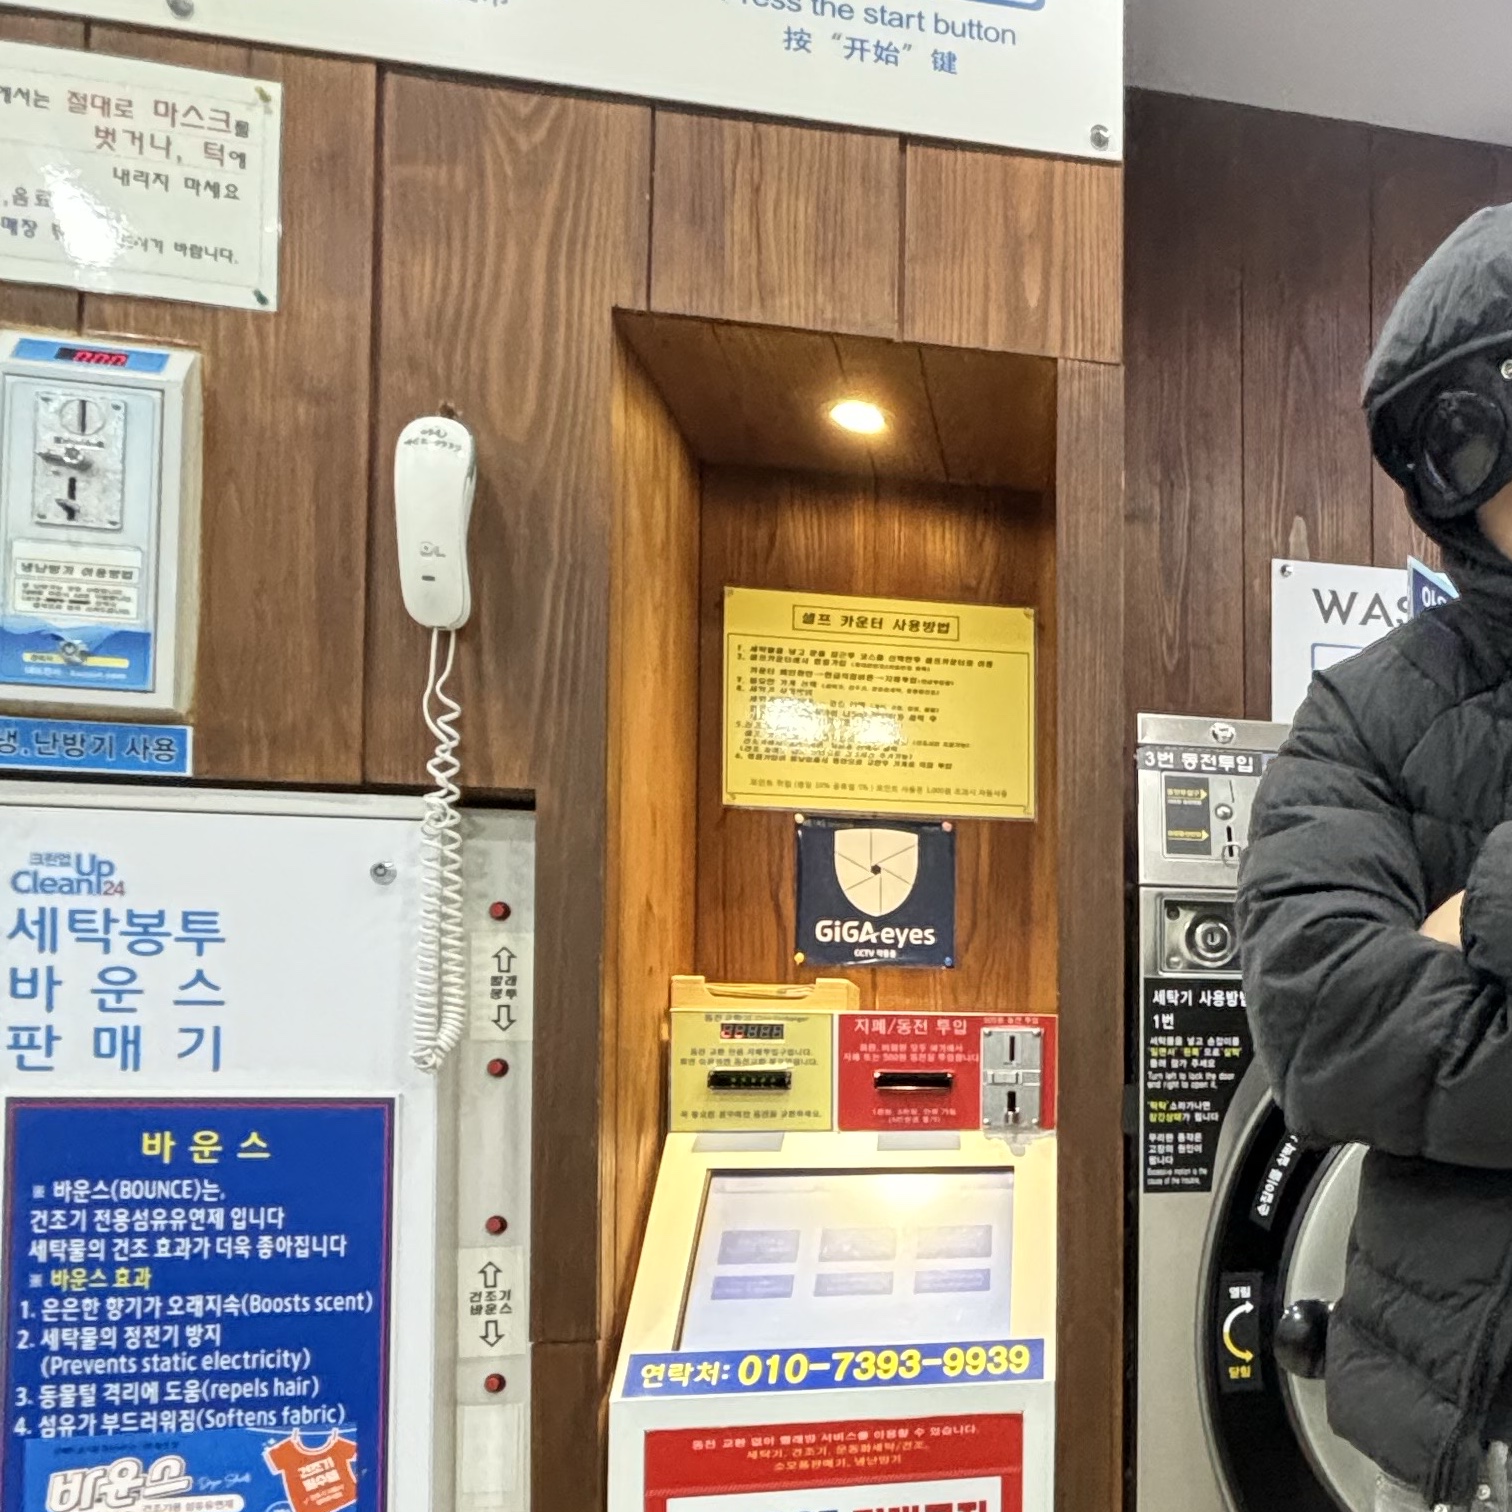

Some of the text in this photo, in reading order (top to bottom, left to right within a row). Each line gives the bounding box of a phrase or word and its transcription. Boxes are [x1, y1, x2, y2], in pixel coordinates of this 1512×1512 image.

[812, 0, 1017, 45] the start button
[66, 90, 134, 120] 절대로
[153, 99, 249, 138] 마스크를
[94, 125, 246, 169] 벗거나, 턱에
[113, 166, 240, 200] 내리지 마세요
[174, 242, 238, 264] 바랍니다.
[802, 611, 951, 635] 셀프 카운터 사용방법
[126, 734, 177, 763] 사용
[1145, 751, 1254, 774] 3번 동전투입
[103, 880, 126, 897] 24
[7, 906, 226, 957] 세탁봉투
[1152, 989, 1193, 1006] 세탁기
[854, 1018, 928, 1035] 지폐/동전
[936, 1018, 967, 1036] 투입
[1153, 1013, 1175, 1030] 1번
[30, 1206, 285, 1233] 건조기 전용섬유유연제 입니다
[28, 1234, 348, 1263] 세탁물의 건조 효과가 더욱 좋아집니다
[50, 1266, 152, 1291] 바운스 효과
[41, 1298, 101, 1322] 은은한
[106, 1296, 163, 1321] 향기가
[314, 1290, 374, 1314] scent)
[470, 1303, 513, 1316] 바운스
[40, 1323, 222, 1350] 세탁물의 정전기 방지
[41, 1347, 312, 1378] (Prevents static electricity)
[640, 1343, 1031, 1389] 연락처: 010-7393-9939
[38, 1381, 97, 1409] 동물털
[103, 1380, 160, 1406] 격리에
[273, 1375, 320, 1400] hair)
[37, 1411, 97, 1439] 섬유가
[282, 1402, 346, 1427] fabric)
[821, 1431, 869, 1443] 서비스를
[873, 1427, 909, 1440] 이용할
